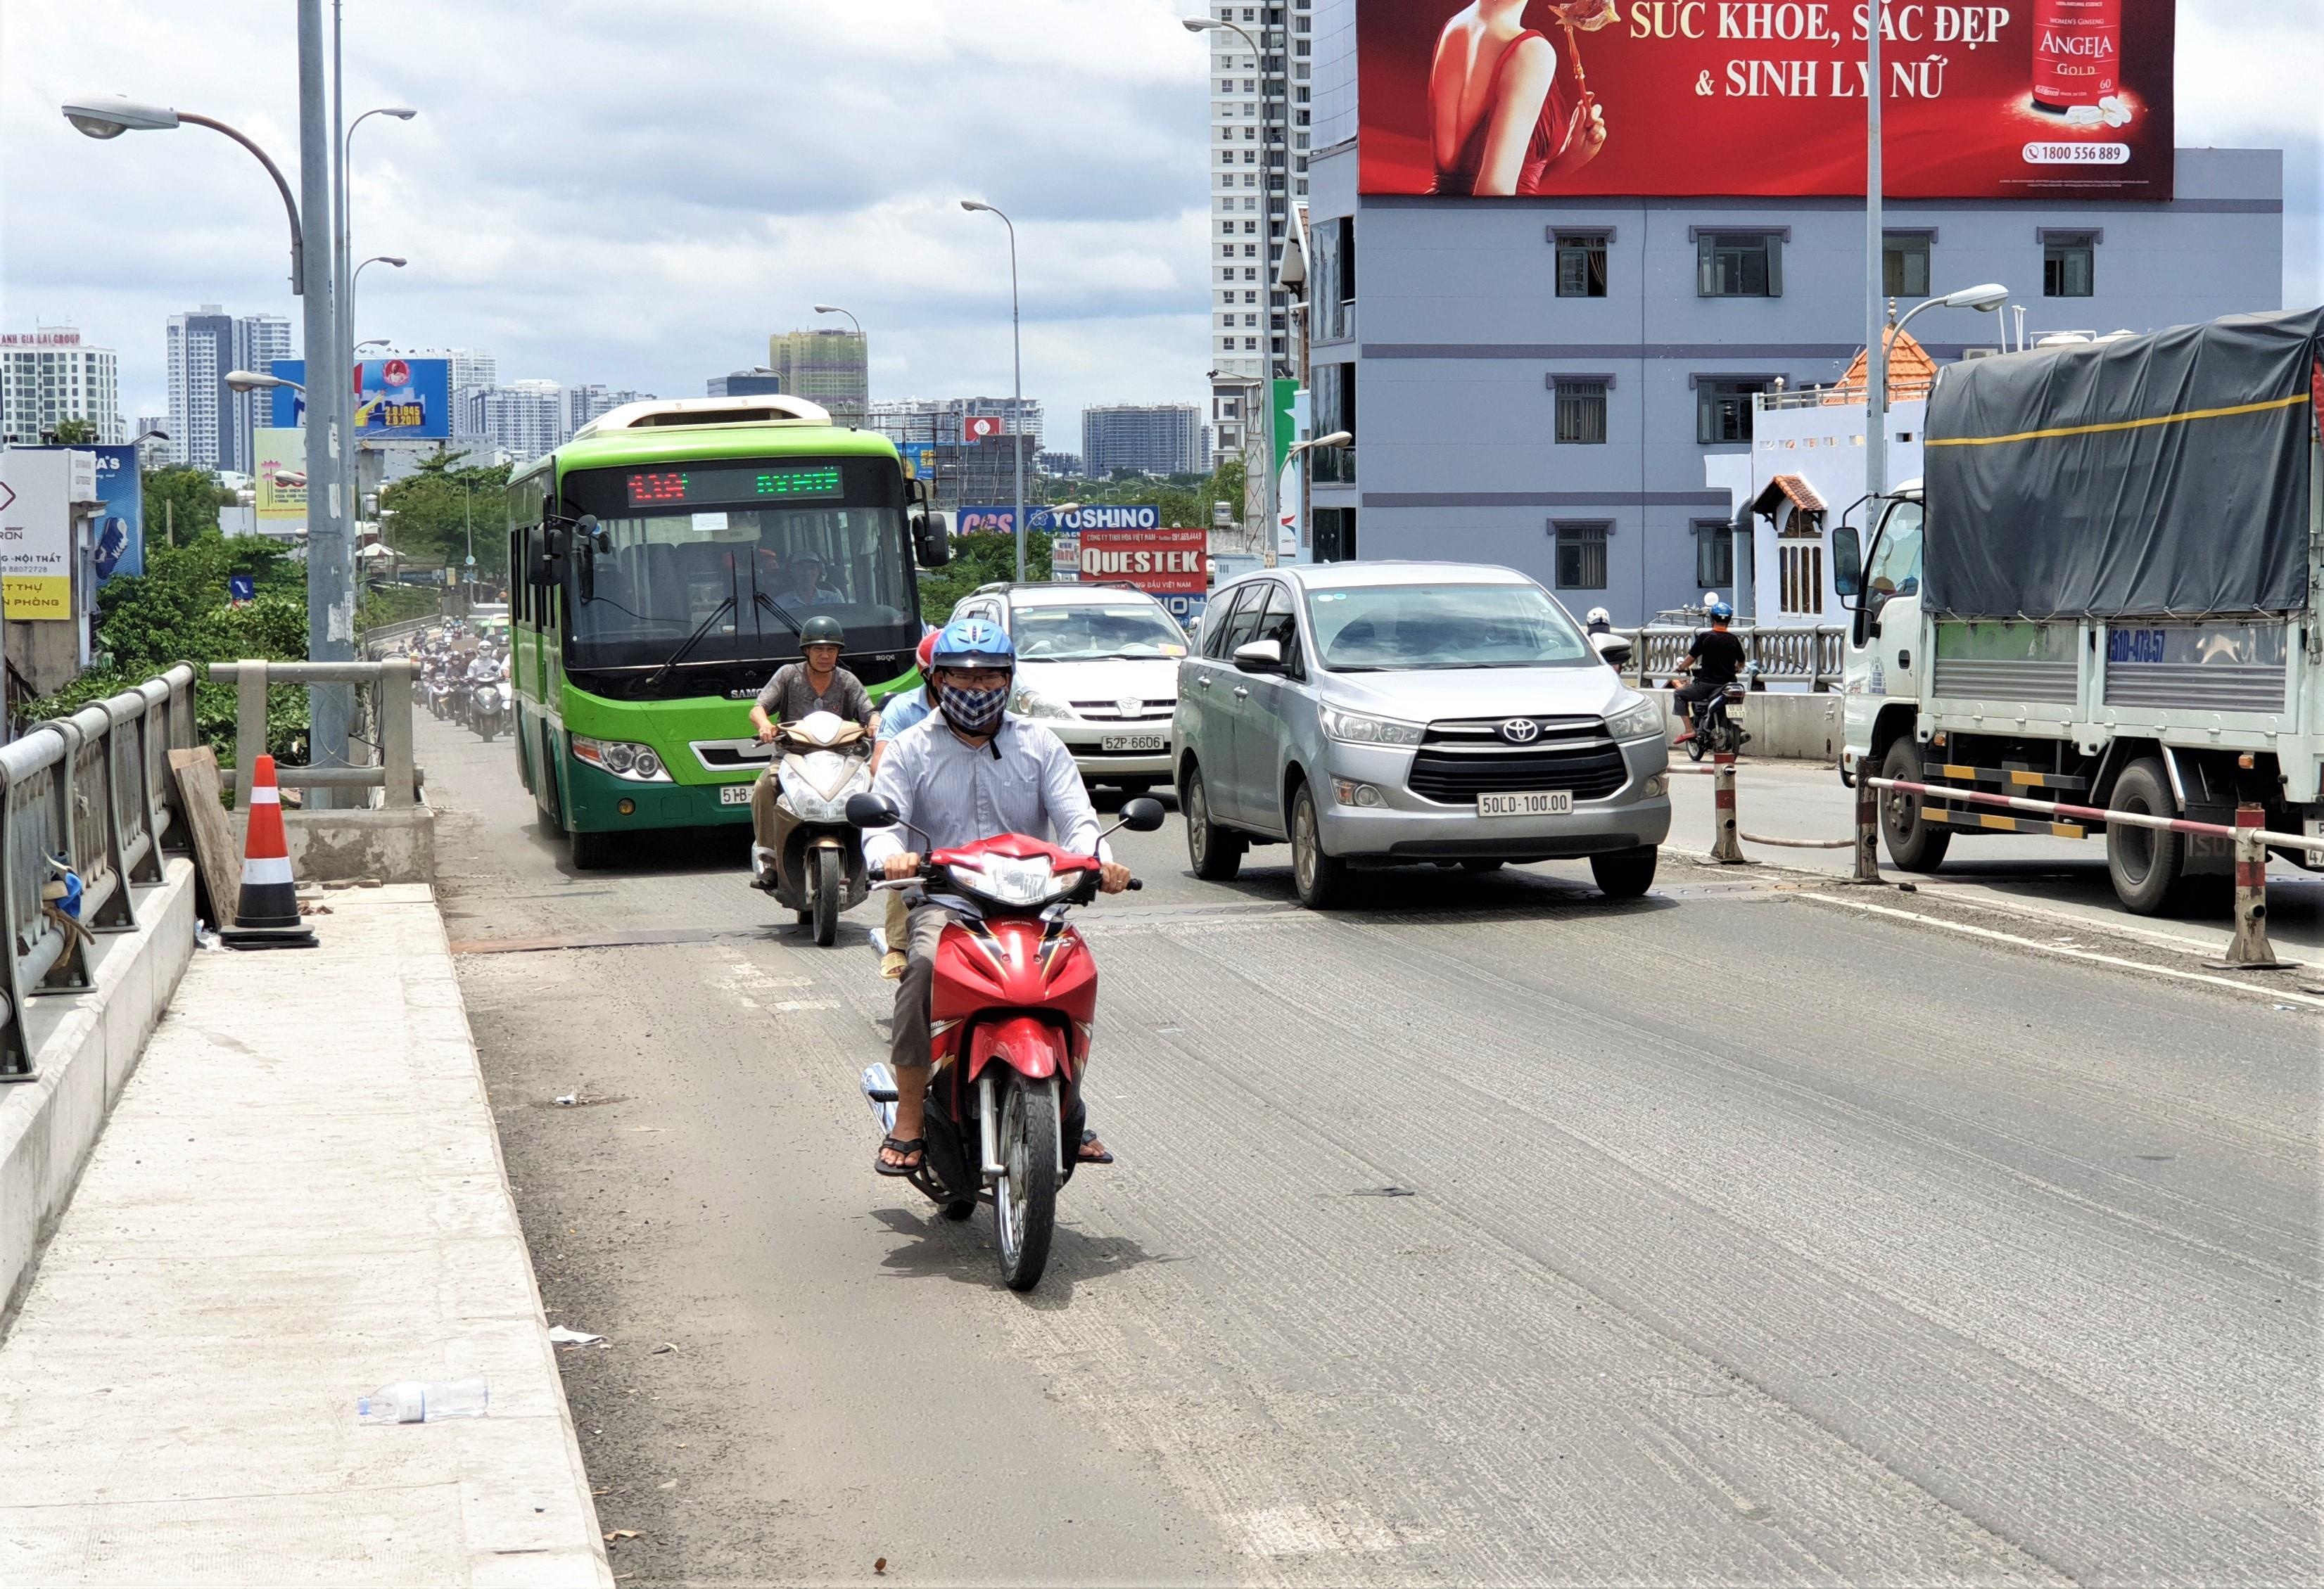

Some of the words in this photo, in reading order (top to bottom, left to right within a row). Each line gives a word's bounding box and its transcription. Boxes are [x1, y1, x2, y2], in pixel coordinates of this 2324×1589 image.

[1934, 6, 2009, 50] ĐẸP
[2039, 30, 2113, 58] ANGELA
[1695, 70, 1715, 96] &
[1726, 59, 1818, 96] SINH
[1890, 54, 1948, 98] NỮ
[2057, 63, 2095, 75] GOLD
[2100, 79, 2111, 89] 60
[2043, 146, 2071, 160] 1800
[2074, 147, 2096, 160] 556
[2099, 147, 2121, 160] 889
[1, 335, 18, 343] ANH
[22, 335, 34, 343] GIA
[37, 335, 51, 343] LAI
[53, 334, 80, 344] GROUP
[1052, 509, 1155, 528] YOSHINO
[1082, 548, 1200, 576] QUESTEK
[14, 596, 59, 606] PHÒNG
[1105, 736, 1161, 750] 52P-6606
[723, 788, 754, 803] 51B-
[1482, 795, 1568, 813] 50LD-100.00
